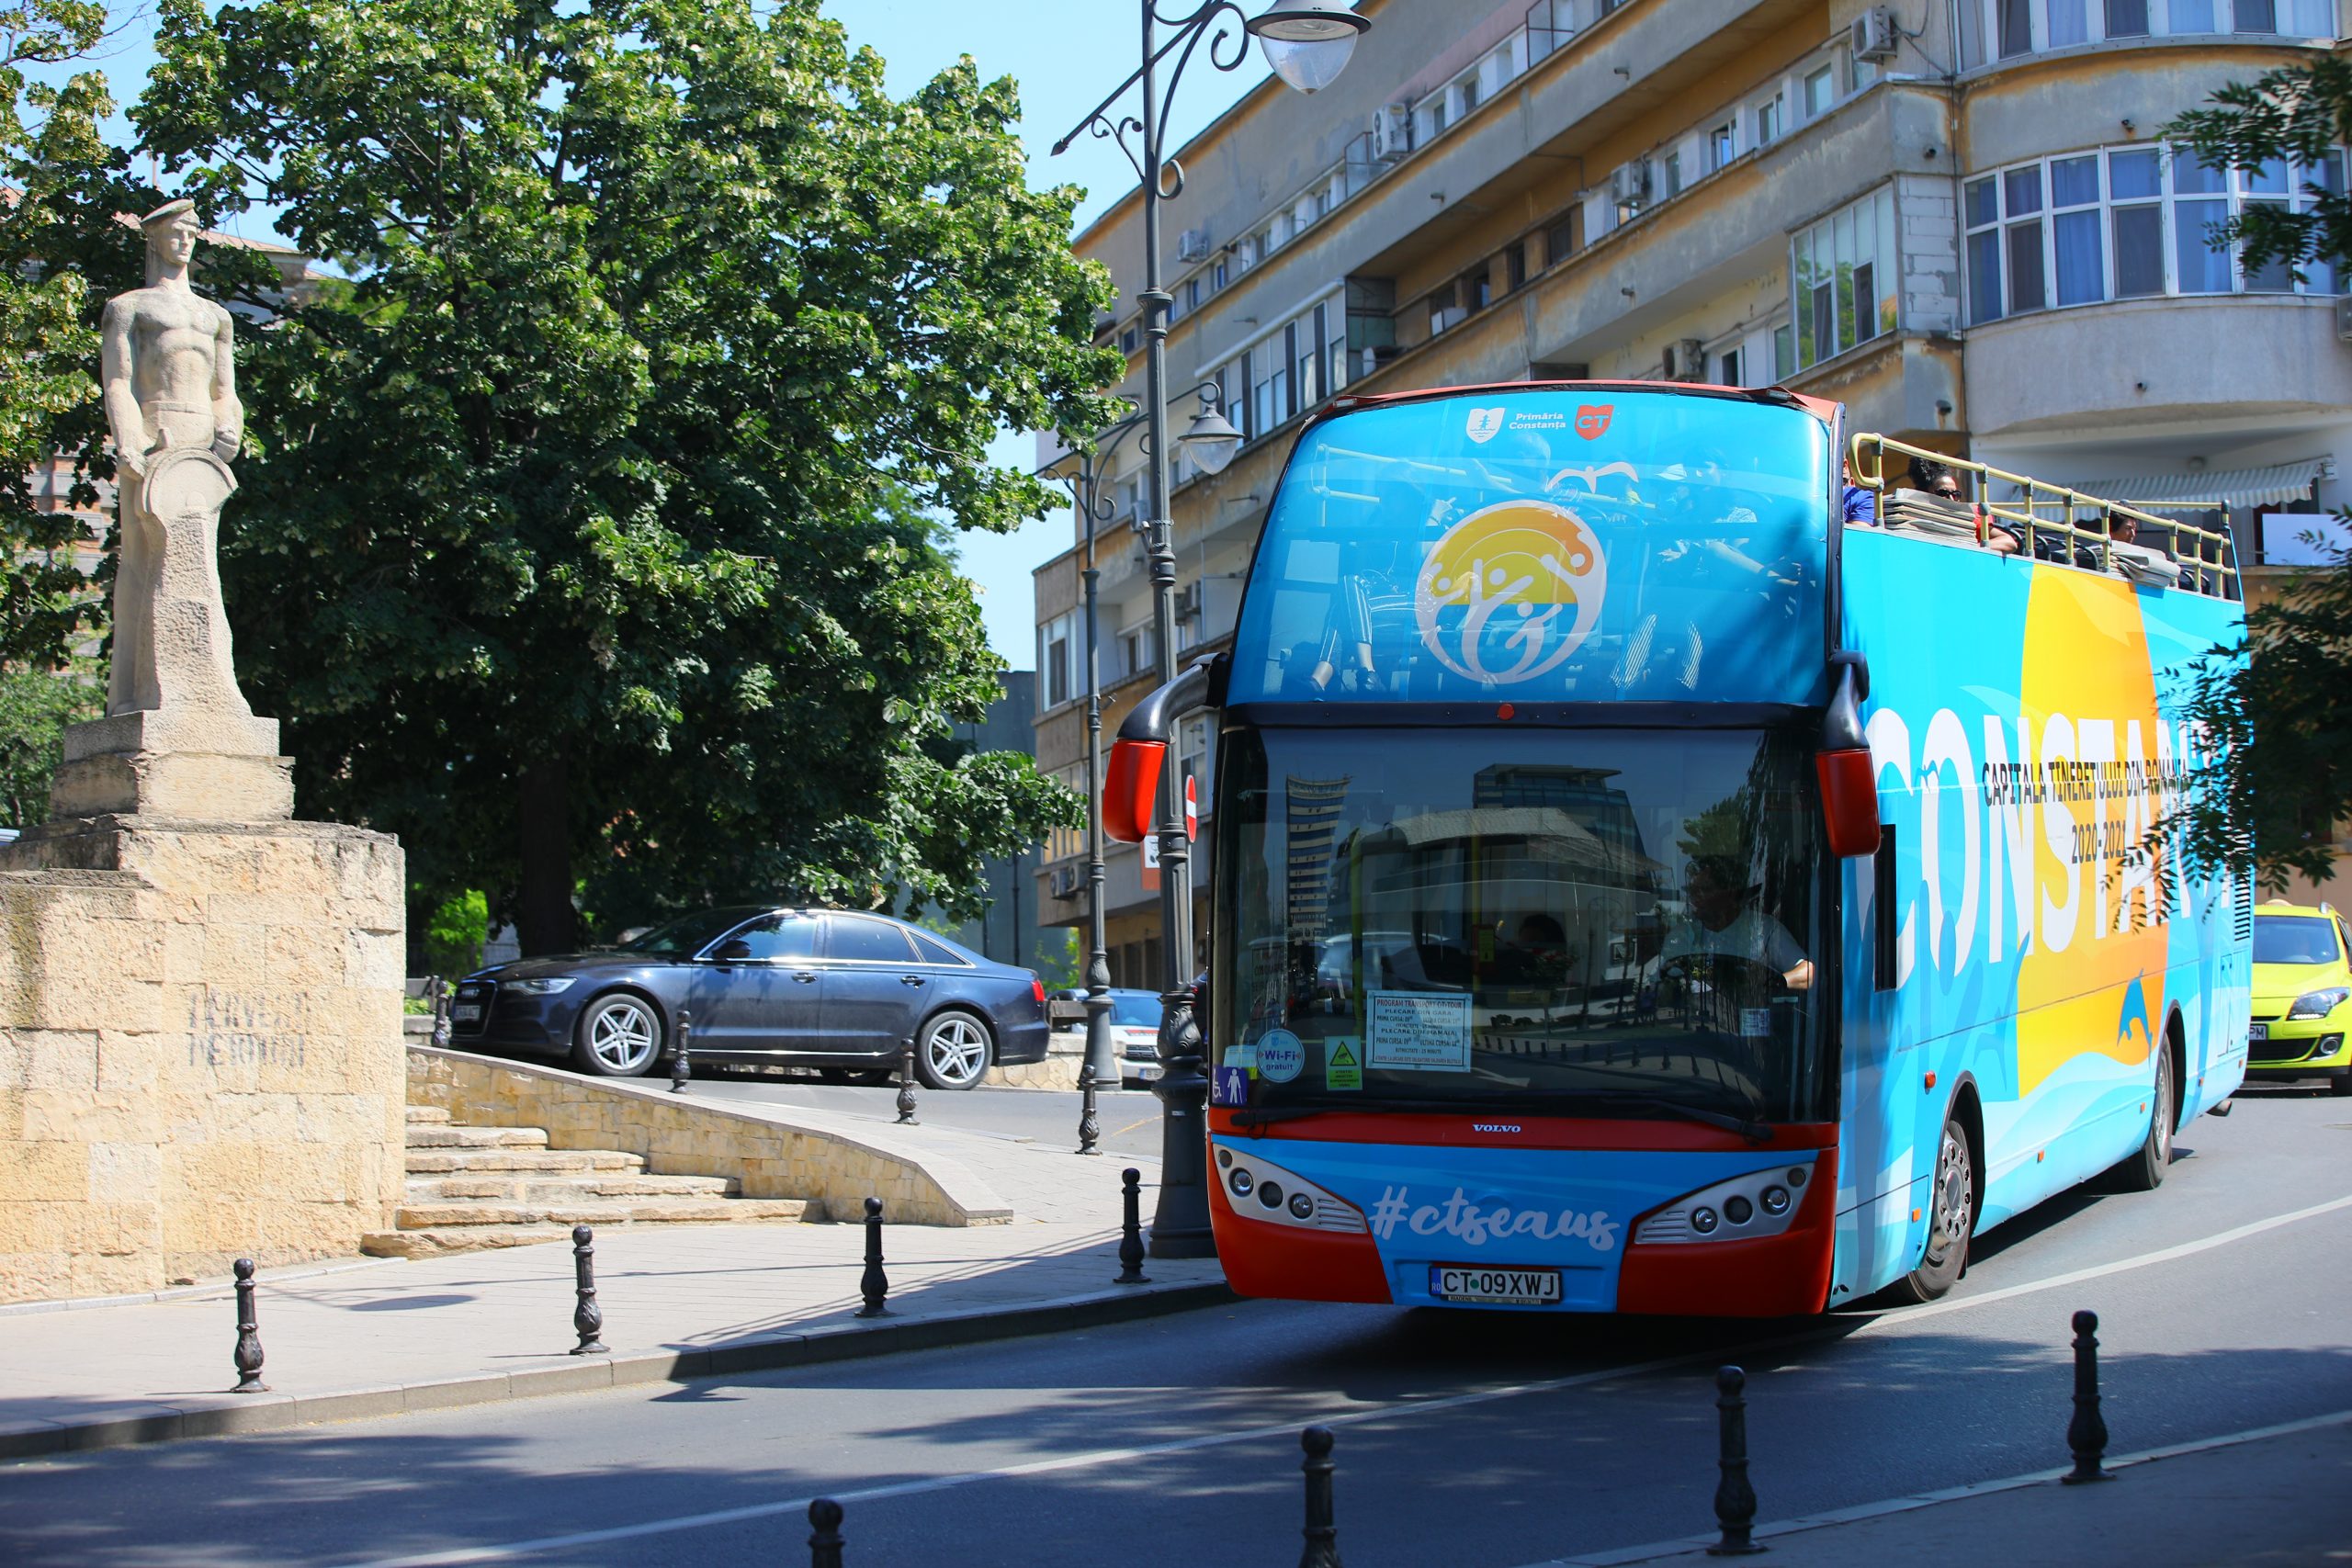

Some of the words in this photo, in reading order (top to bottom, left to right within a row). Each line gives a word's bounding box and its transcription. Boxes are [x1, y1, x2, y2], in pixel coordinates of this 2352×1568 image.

[1515, 412, 1564, 421] Primăria
[1577, 414, 1609, 429] CT
[1982, 761, 2047, 807] CAPITALA
[2048, 760, 2123, 803] TINERETULUI
[2125, 759, 2143, 797] DIN
[2071, 819, 2127, 863] 2020-2021
[1376, 998, 1404, 1008] PROGRAM
[1264, 1050, 1296, 1061] Wi-Fi
[1265, 1063, 1294, 1071] gratuit
[1473, 1123, 1521, 1133] VOLVO
[1368, 1185, 1621, 1251] #ctseaus
[1443, 1271, 1473, 1293] CT
[1480, 1272, 1555, 1296] 09XWJ
